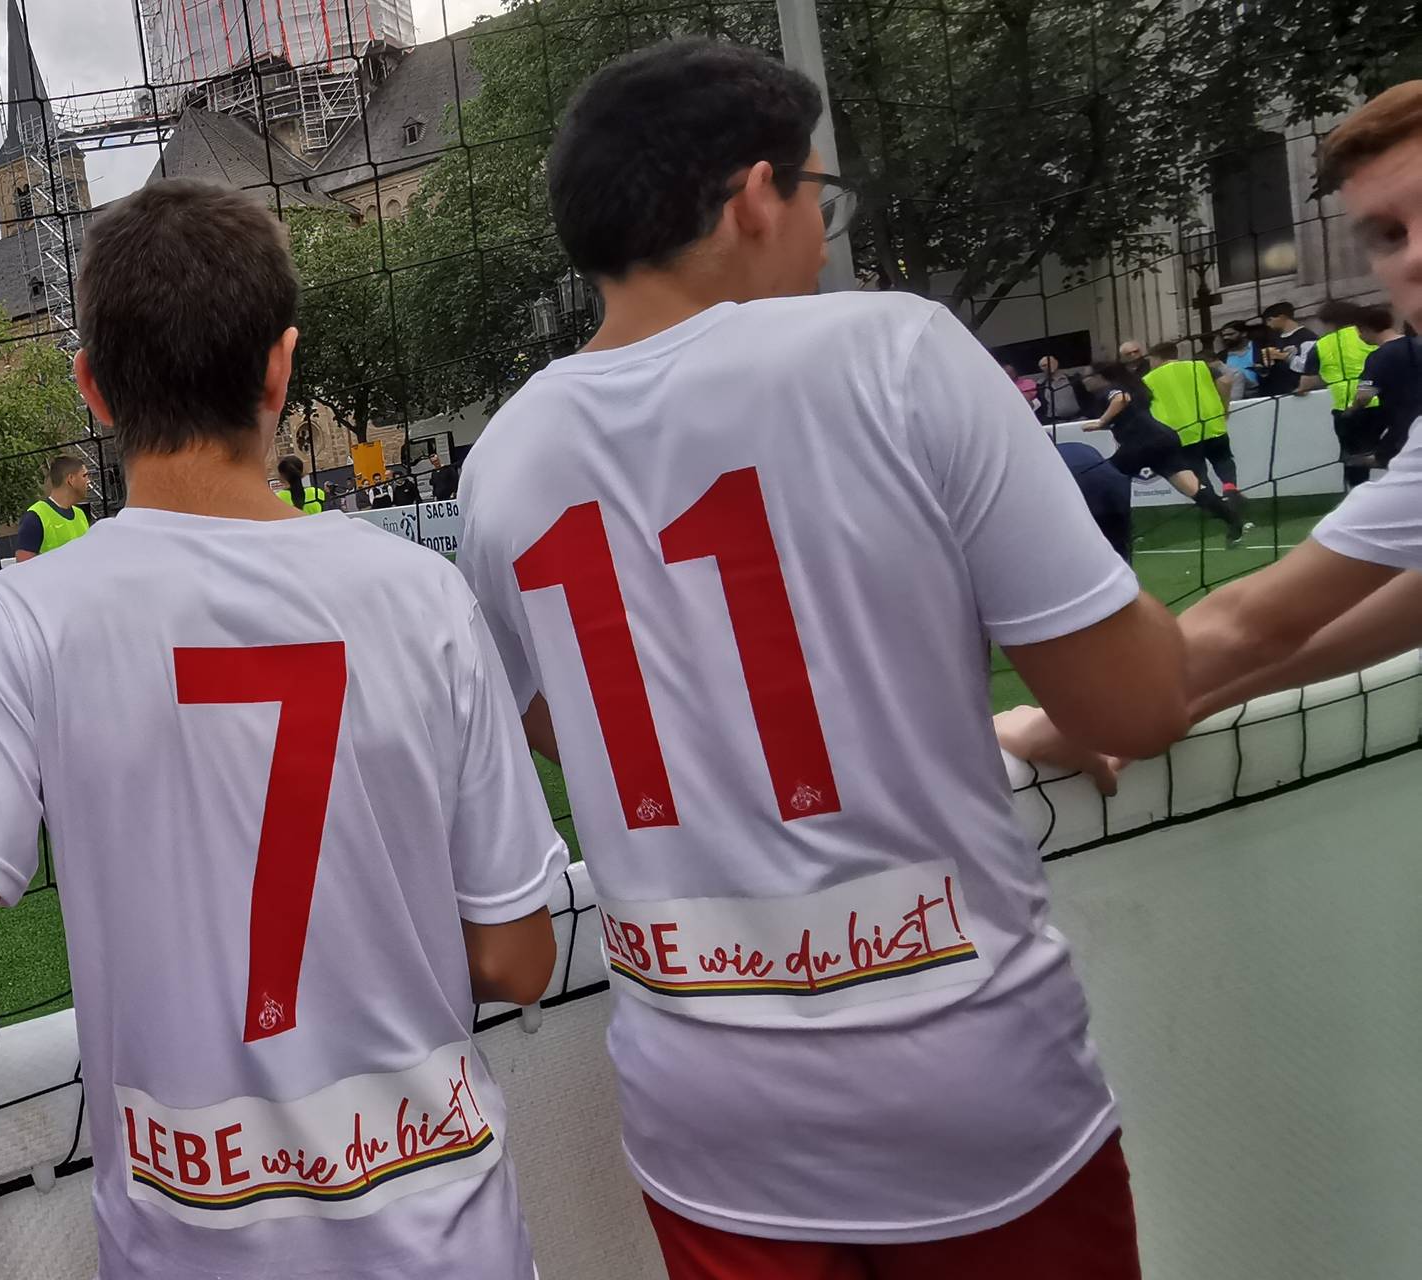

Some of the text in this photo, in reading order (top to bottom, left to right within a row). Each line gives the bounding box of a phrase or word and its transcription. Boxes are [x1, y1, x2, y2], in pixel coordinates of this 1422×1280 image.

[426, 503, 444, 519] SAC
[512, 465, 842, 830] 11
[173, 641, 347, 1043] 7
[598, 904, 687, 976] LEBE
[698, 943, 775, 978] wie
[785, 929, 841, 992] du
[124, 1106, 251, 1187] LEBE
[261, 1148, 338, 1185] wie
[345, 1112, 390, 1185] du
